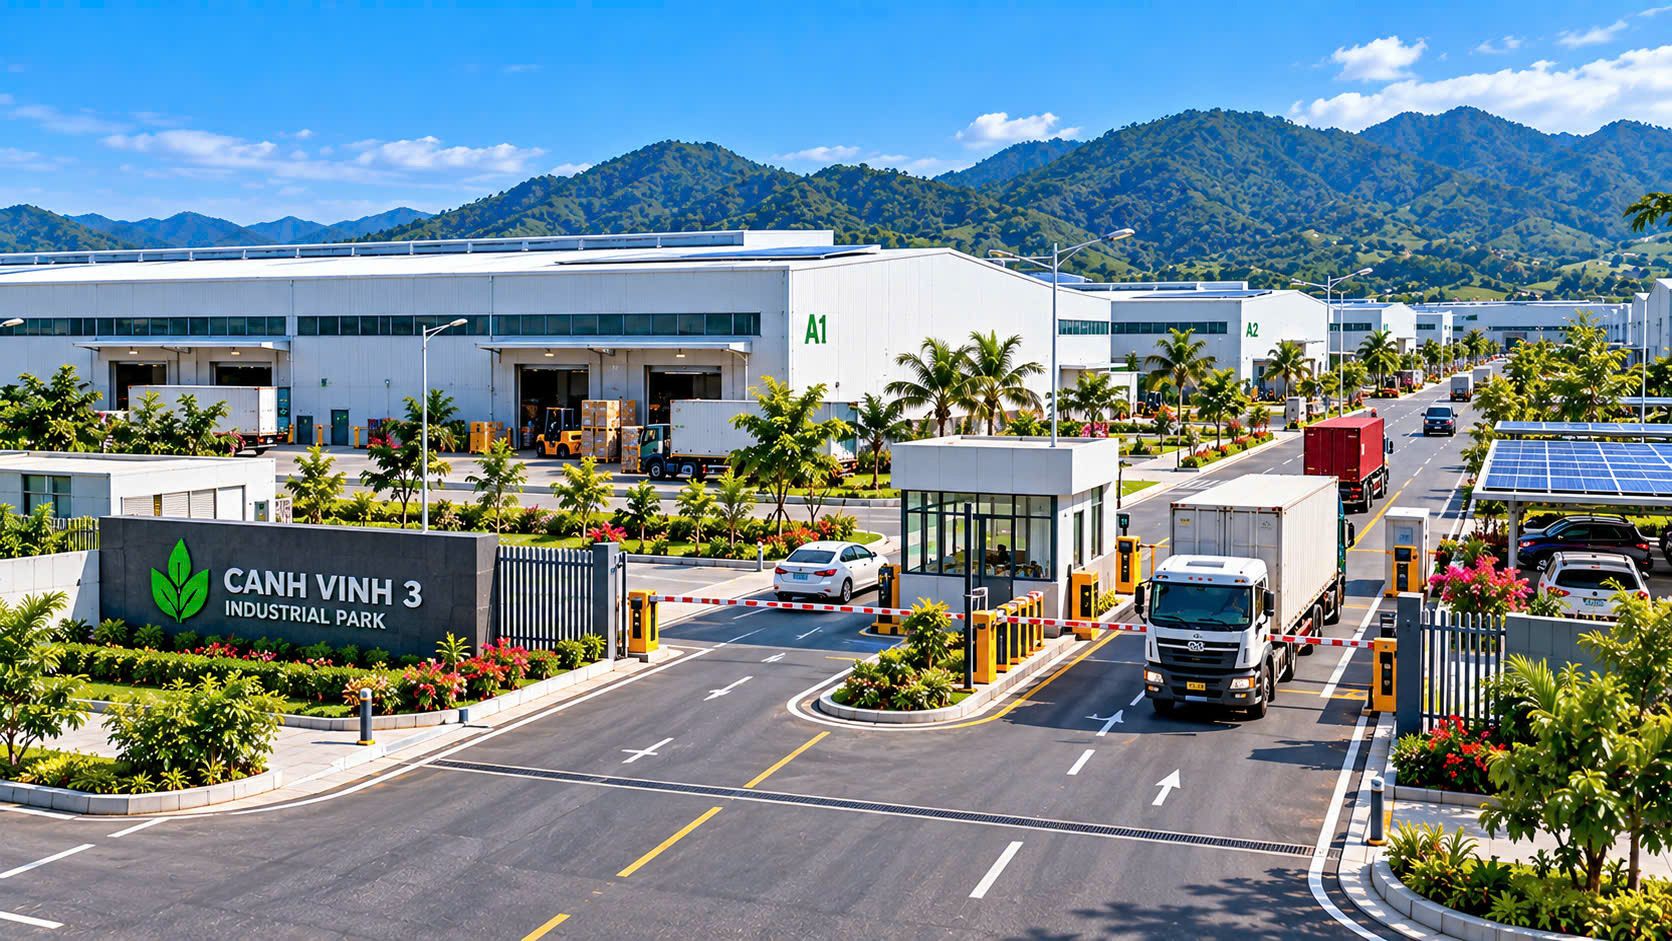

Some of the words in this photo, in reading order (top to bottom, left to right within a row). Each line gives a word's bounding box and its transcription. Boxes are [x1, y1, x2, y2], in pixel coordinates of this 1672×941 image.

[804, 314, 826, 344] A1
[1246, 321, 1259, 338] A2
[223, 567, 307, 598] CANH
[315, 573, 393, 606] VINH
[403, 580, 422, 608] 3
[225, 600, 330, 625] INDUSTRIAL
[336, 609, 386, 629] PARK
